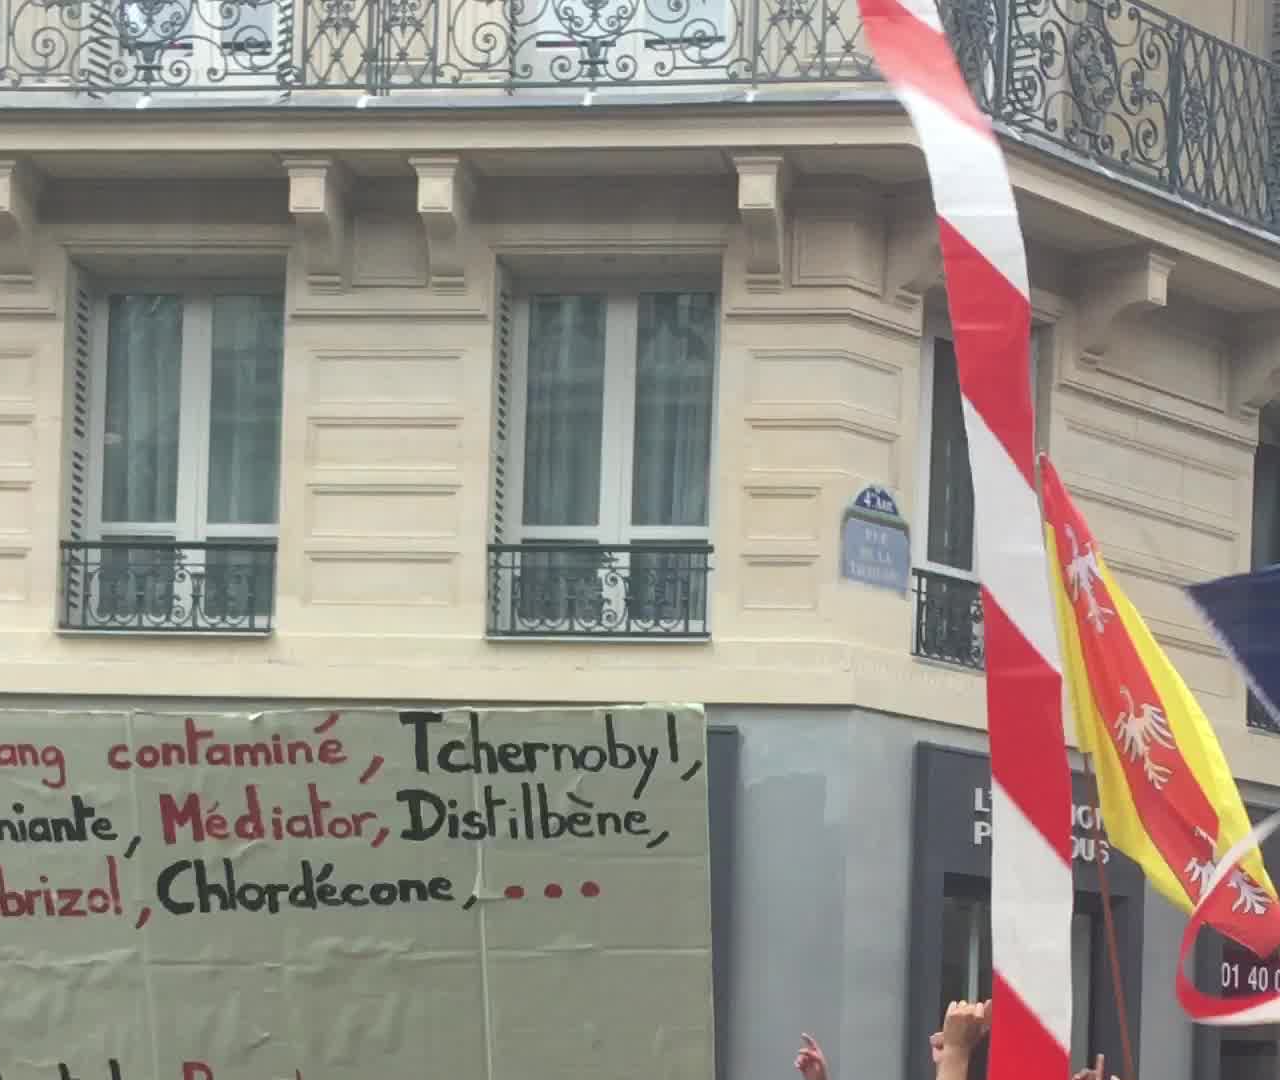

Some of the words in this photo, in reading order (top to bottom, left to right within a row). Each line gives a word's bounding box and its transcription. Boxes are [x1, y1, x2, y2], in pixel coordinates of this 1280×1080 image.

[159, 783, 391, 849] Médiator,
[396, 781, 669, 849] Distilbène,
[1221, 962, 1240, 989] 01
[1247, 965, 1269, 992] 40
